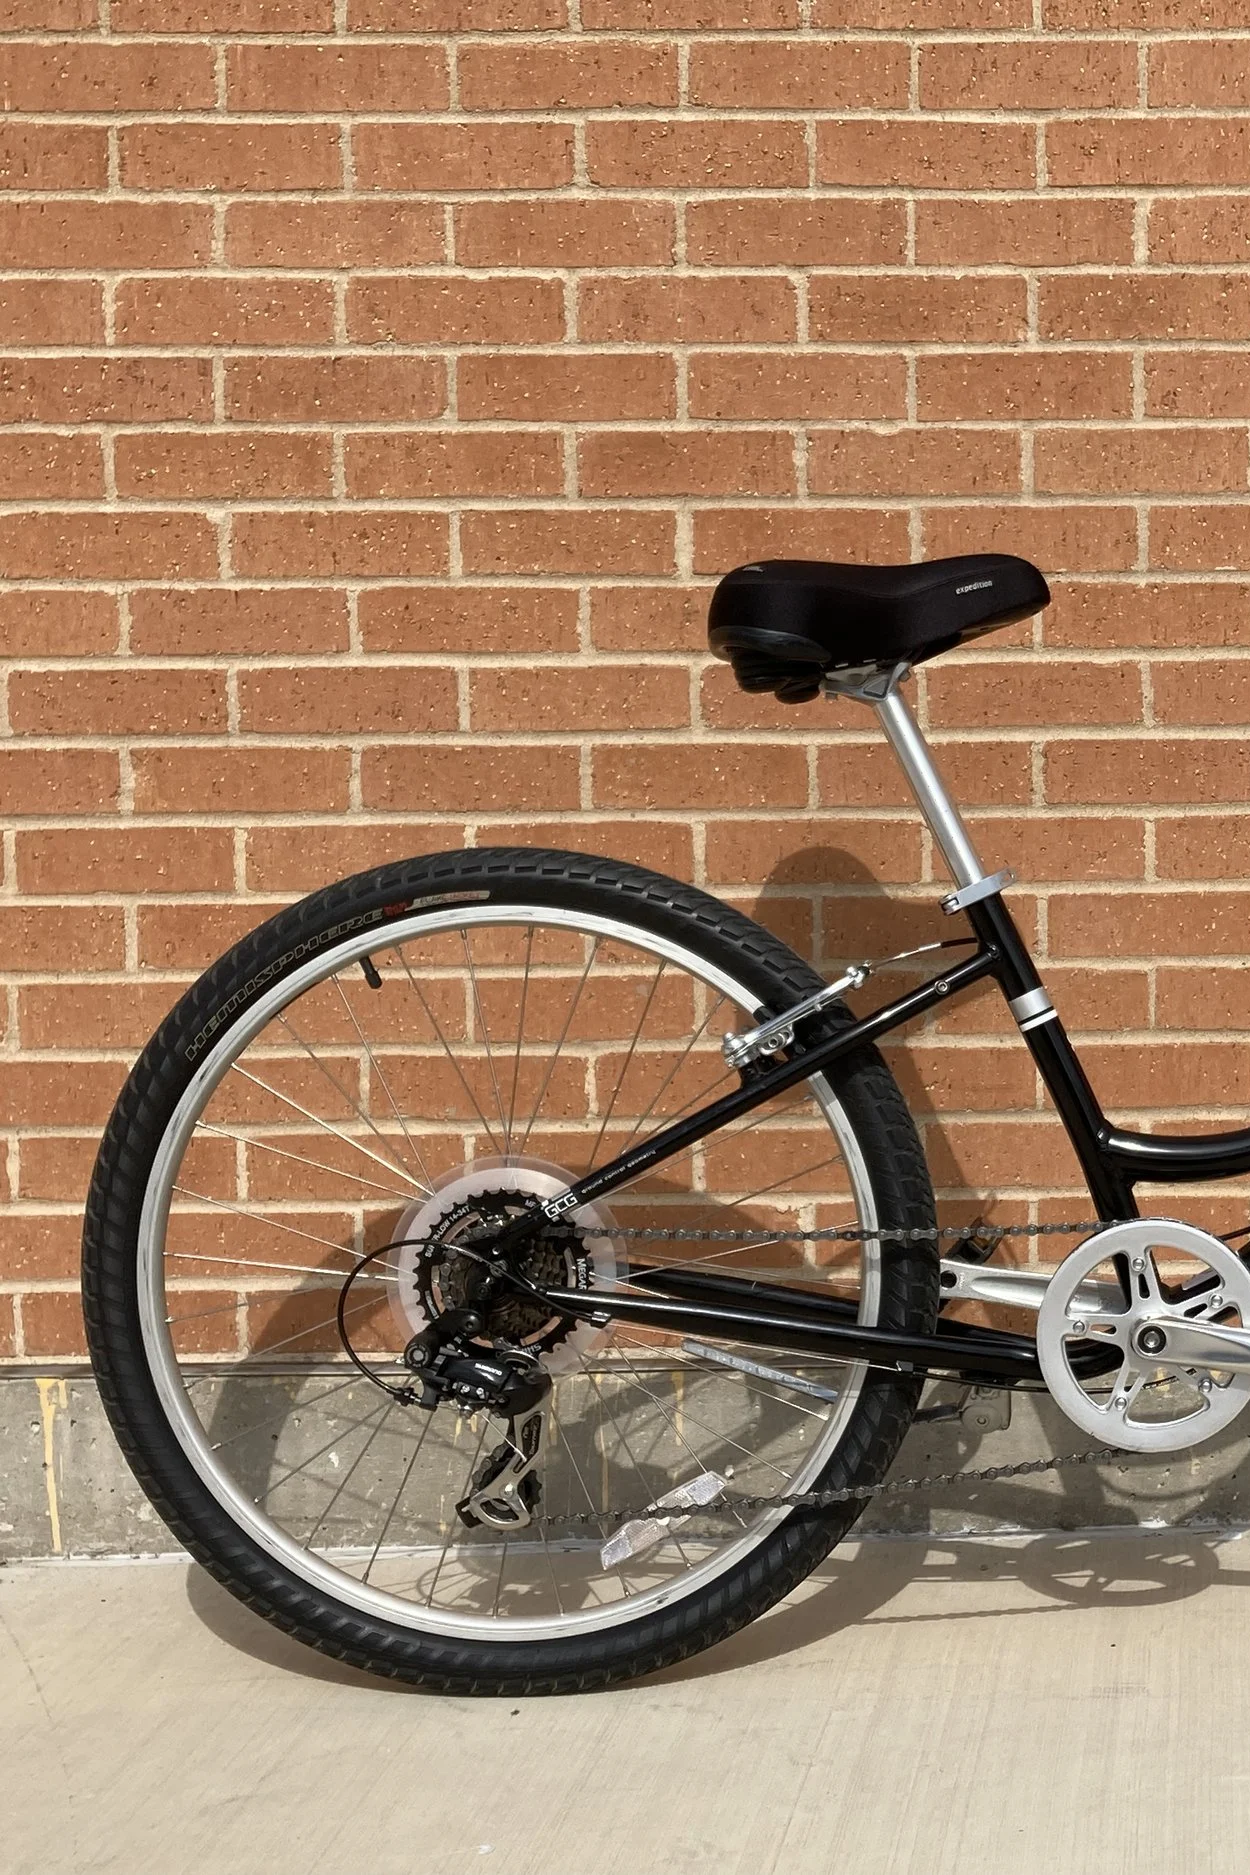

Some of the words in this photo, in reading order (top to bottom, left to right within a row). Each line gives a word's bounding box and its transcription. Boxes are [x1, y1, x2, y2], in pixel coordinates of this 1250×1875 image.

[955, 580, 993, 595] expedition
[184, 907, 385, 1062] HEMISPHERE
[581, 1178, 604, 1194] ground
[604, 1167, 626, 1181] control
[544, 1192, 578, 1218] GCG
